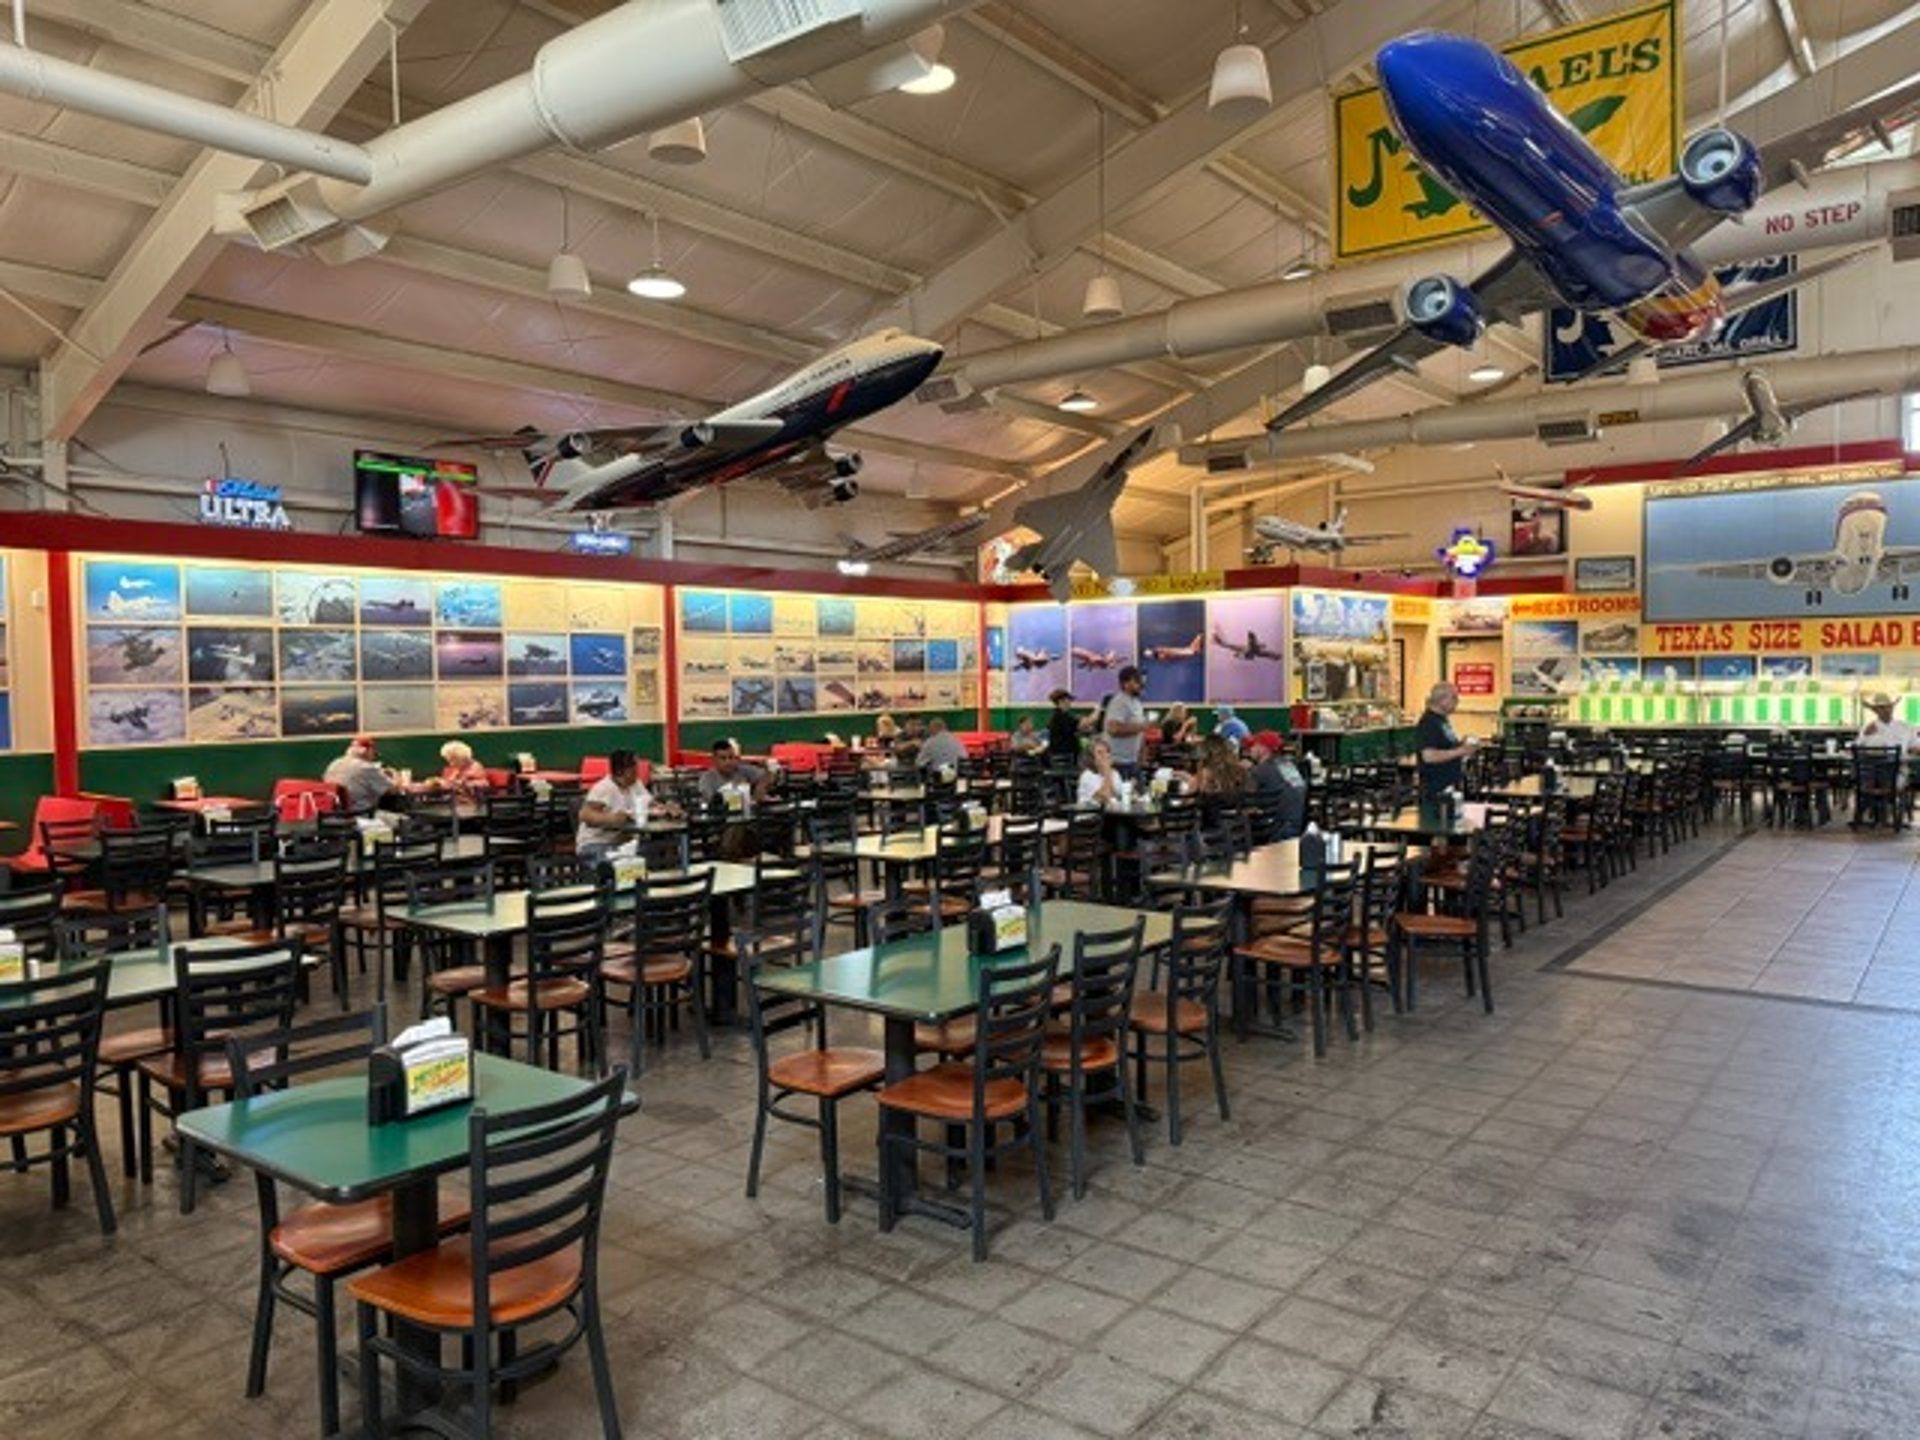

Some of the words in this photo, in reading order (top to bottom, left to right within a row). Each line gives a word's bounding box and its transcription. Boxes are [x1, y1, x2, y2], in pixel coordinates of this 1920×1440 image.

[1765, 216, 1795, 235] NO
[1804, 203, 1862, 228] STEP
[200, 494, 291, 527] ULTRA
[1533, 596, 1640, 616] RESTROOMS
[1656, 623, 1734, 652] TEXAS
[1749, 622, 1802, 650] SIZE
[1820, 620, 1903, 649] SALAD
